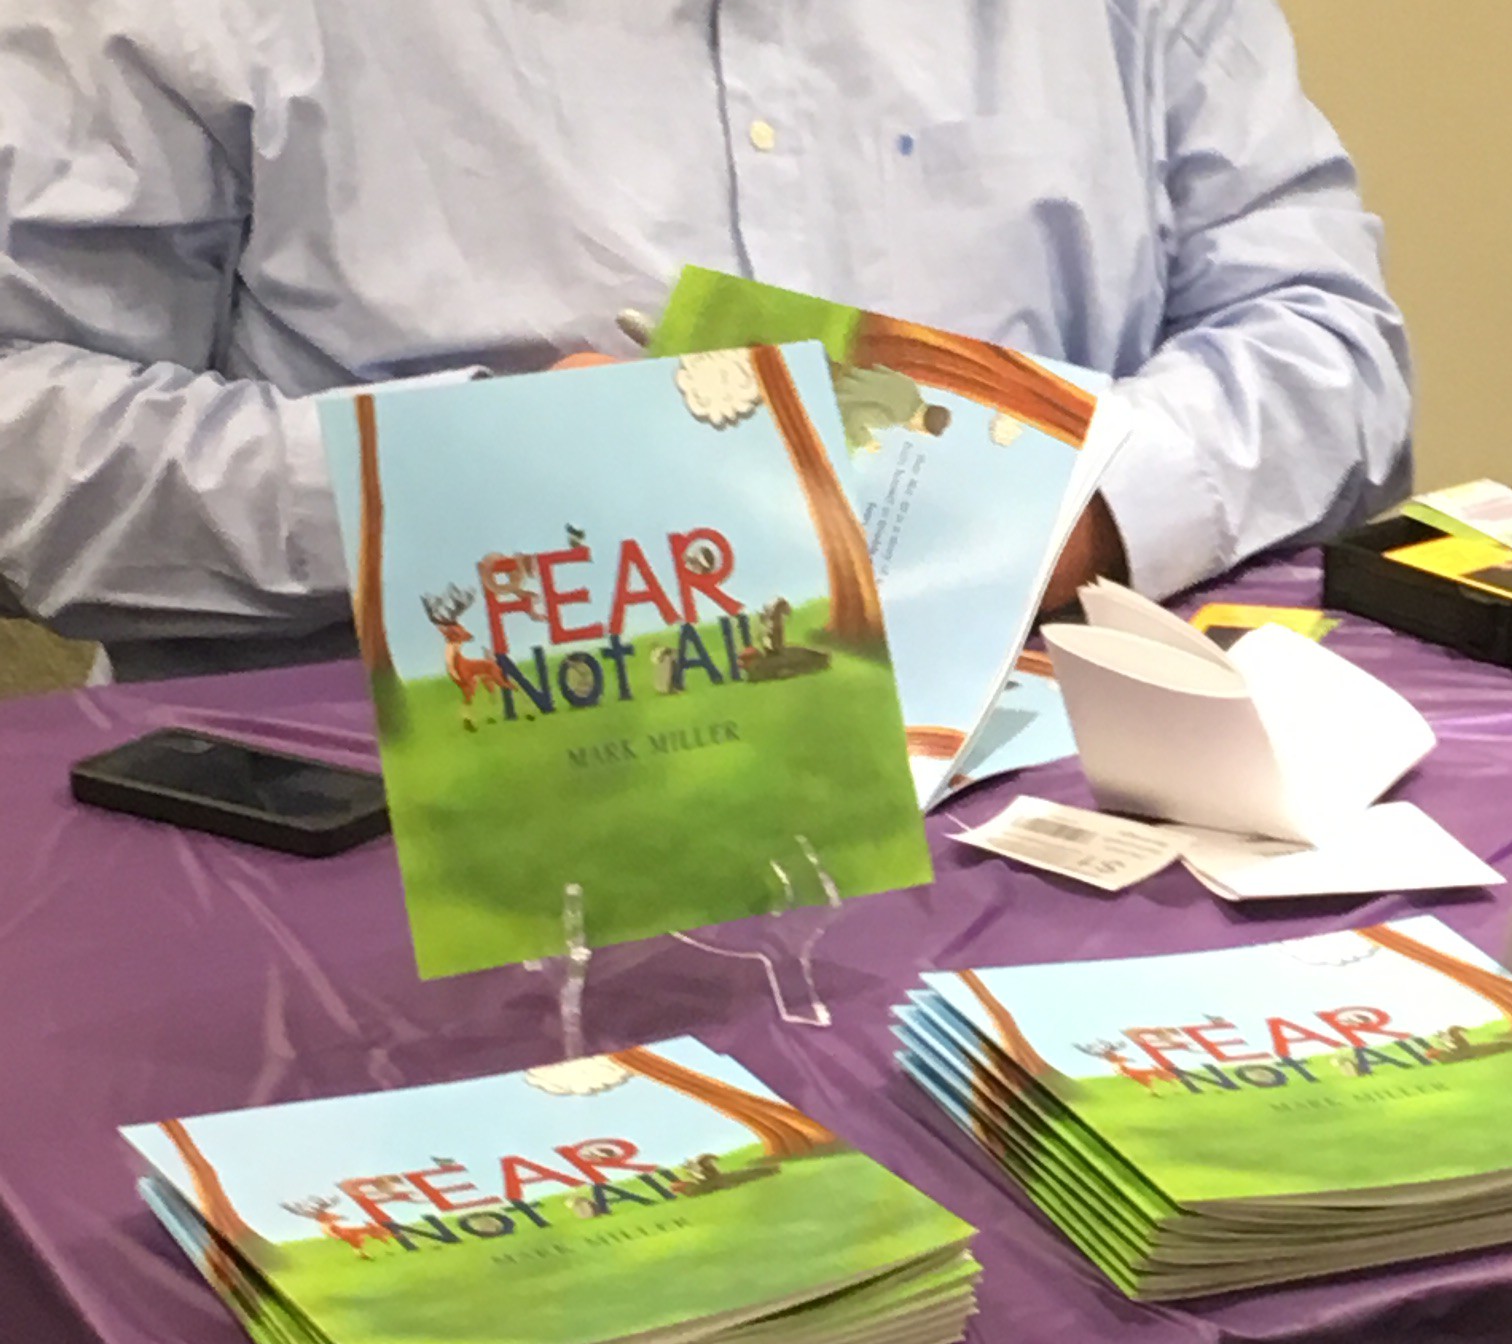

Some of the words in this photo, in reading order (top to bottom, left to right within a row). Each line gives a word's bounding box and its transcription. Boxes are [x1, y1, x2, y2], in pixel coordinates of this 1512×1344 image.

[477, 527, 745, 656] FEAR
[567, 739, 638, 769] MARK
[649, 720, 740, 756] MILLER
[1120, 1005, 1413, 1075] FEAR
[336, 1137, 660, 1226] FEAR
